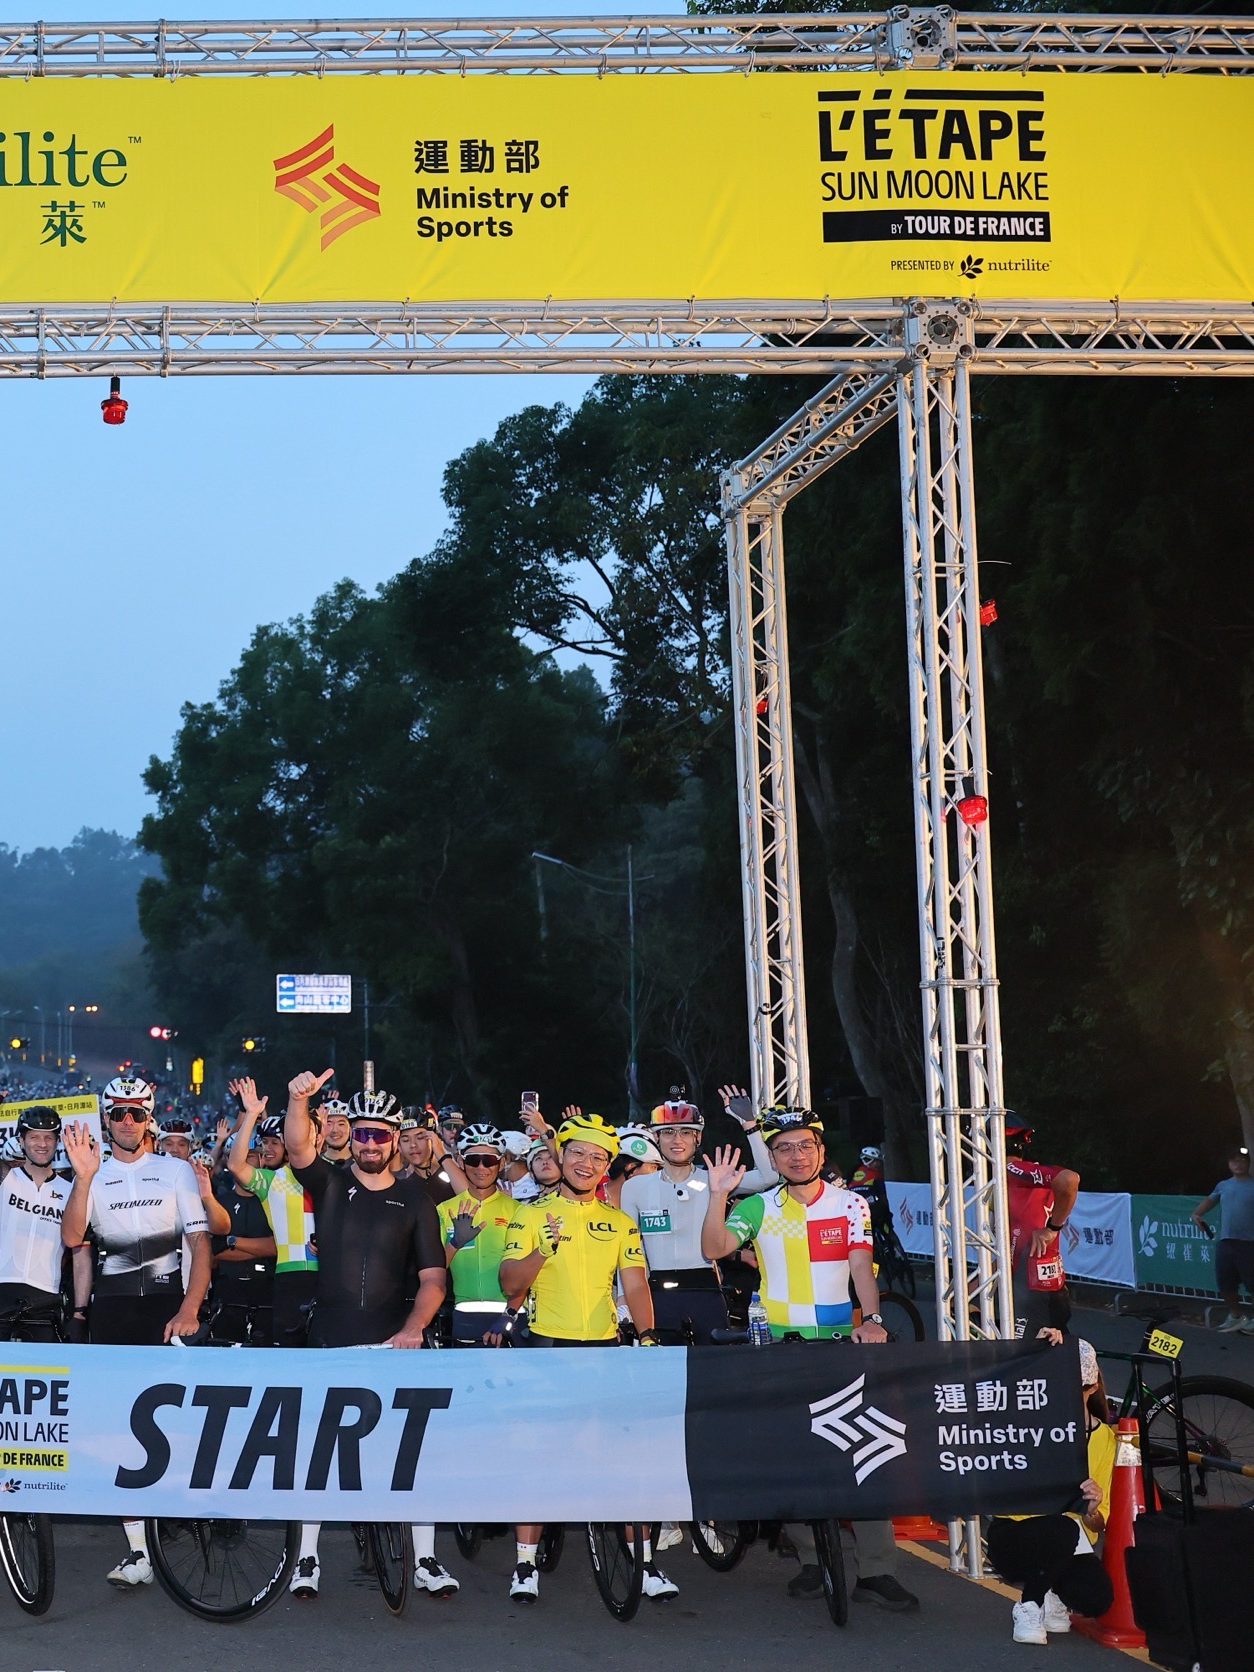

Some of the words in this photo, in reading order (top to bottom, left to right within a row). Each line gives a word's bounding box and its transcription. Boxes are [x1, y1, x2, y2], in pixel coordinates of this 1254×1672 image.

[414, 139, 540, 174] 運動部
[820, 171, 878, 201] SUN
[887, 169, 975, 199] MOON
[983, 172, 1049, 200] LAKE
[417, 186, 533, 213] Ministry
[540, 186, 569, 209] of
[416, 216, 514, 242] Sports
[891, 223, 903, 234] BY
[904, 216, 951, 235] TOUR
[954, 217, 975, 235] DE
[979, 217, 1044, 236] FRANCE
[891, 260, 941, 271] PRESENTED
[943, 260, 955, 271] BY
[988, 258, 1050, 272] nutrilite
[8, 1193, 64, 1220] BELGIAN
[108, 1199, 163, 1211] SPECIALIZED
[589, 1221, 618, 1233] LCL
[644, 1217, 666, 1228] 1743
[505, 1241, 523, 1250] CL
[1165, 1242, 1211, 1262] 紐崔萊
[1150, 1336, 1177, 1355] 2182
[934, 1378, 1048, 1415] 運動部
[24, 1422, 69, 1443] LAKE
[114, 1382, 453, 1491] START
[937, 1425, 1043, 1449] Ministry
[1050, 1422, 1077, 1443] of
[3, 1452, 18, 1465] DE
[19, 1453, 64, 1467] FRANCE
[940, 1450, 1028, 1476] Sports
[24, 1482, 66, 1491] nutrilite
